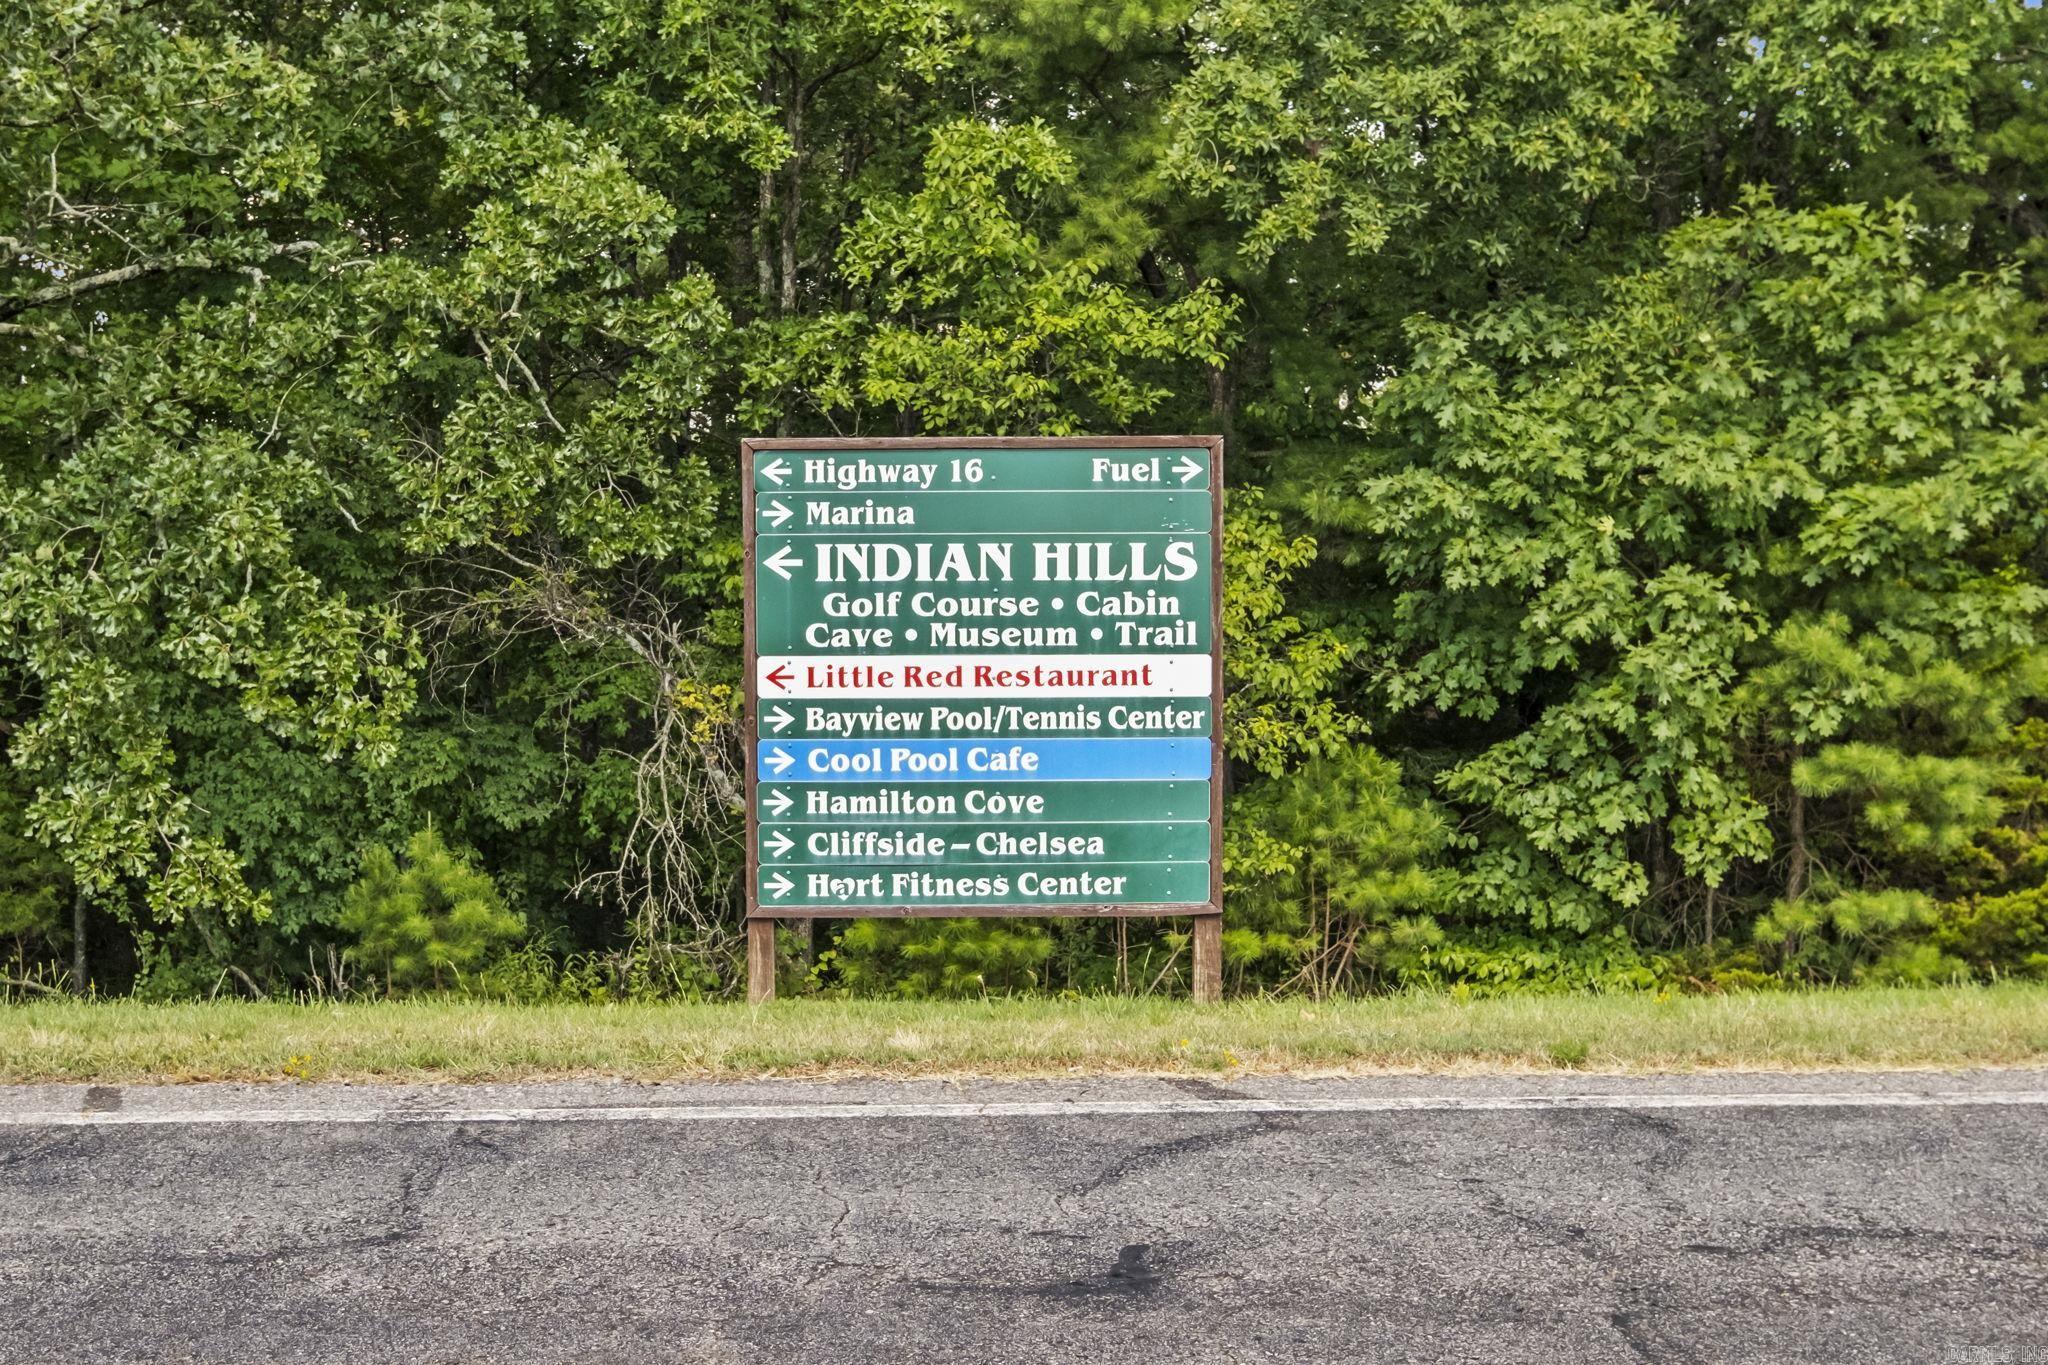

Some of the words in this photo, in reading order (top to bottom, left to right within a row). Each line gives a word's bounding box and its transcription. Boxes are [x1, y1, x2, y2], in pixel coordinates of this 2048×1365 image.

[803, 457, 938, 489] Highway
[950, 457, 984, 484] 16
[1091, 457, 1161, 483] Fuel
[806, 499, 916, 526] Marina
[814, 542, 1014, 583] INDIAN
[1032, 540, 1199, 582] HILLS
[822, 591, 903, 618] Golf
[911, 591, 1040, 617] Course
[1076, 589, 1181, 617] Cabin
[805, 622, 893, 648] Cave
[930, 622, 1078, 647] Museum
[1114, 619, 1198, 648] Trail
[807, 665, 893, 689] Little
[904, 665, 963, 688] Red
[974, 665, 1153, 687] Restaurant
[805, 704, 924, 737] Bayview
[930, 703, 1102, 733] Pool/Tennis
[1107, 705, 1206, 733] Center
[807, 748, 882, 773] Cool
[890, 747, 959, 772] Pool
[966, 746, 1039, 772] Cafe
[806, 788, 957, 815] Hamilton
[964, 789, 1045, 815] Cove
[807, 830, 946, 858] Cliffside
[976, 831, 1105, 856] Chelsea
[891, 871, 1010, 897] Fitness
[1017, 871, 1127, 897] Center
